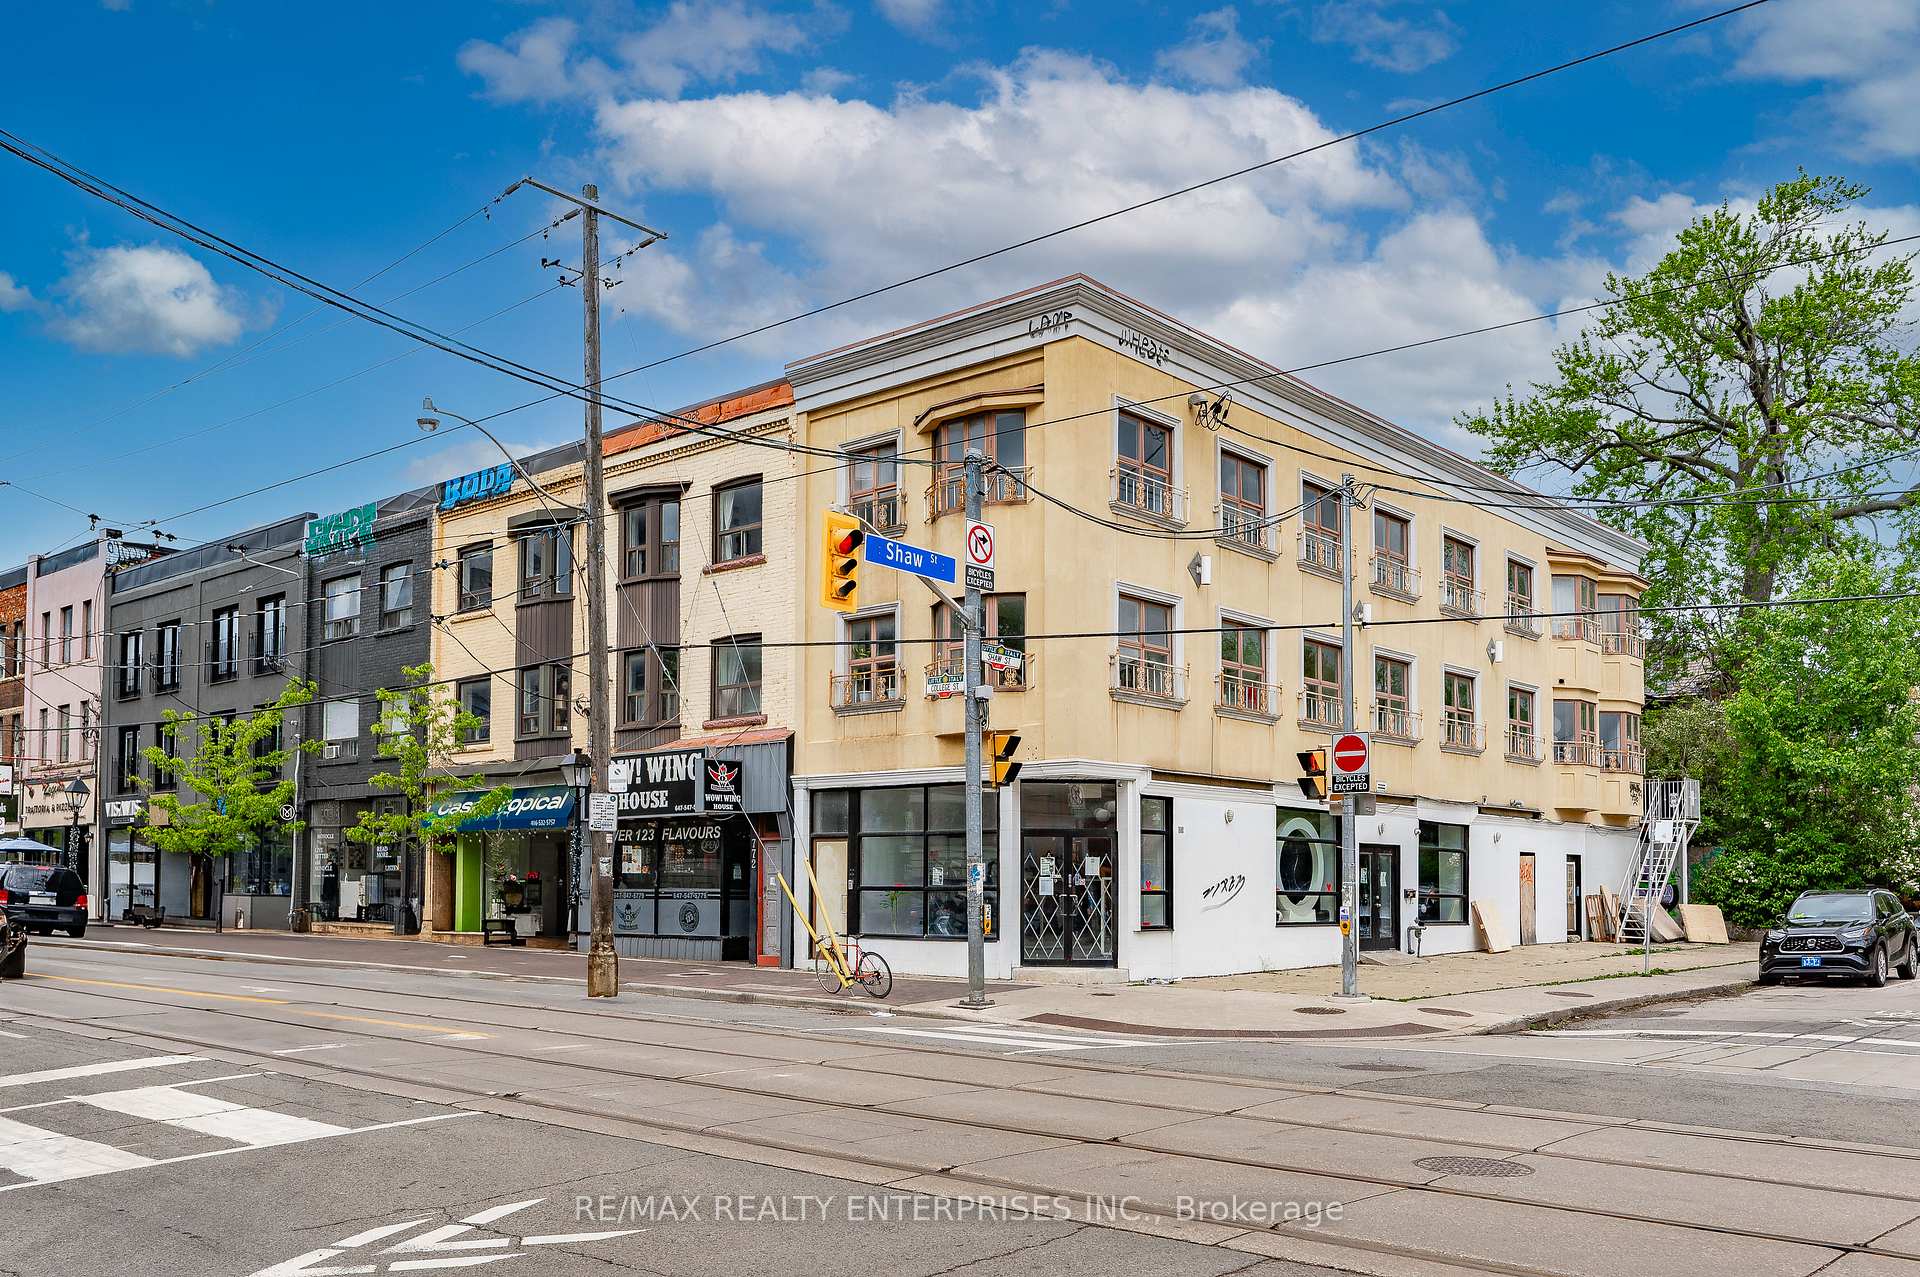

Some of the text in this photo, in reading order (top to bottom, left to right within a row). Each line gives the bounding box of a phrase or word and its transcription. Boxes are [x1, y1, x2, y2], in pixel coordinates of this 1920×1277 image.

[886, 542, 938, 568] Shaw St
[968, 568, 992, 580] BICYCLES
[967, 576, 993, 589] EXCEPTED
[987, 653, 1012, 664] SHAW ST
[1004, 648, 1021, 659] ITALY
[931, 682, 960, 692] COLLEGE ST
[1335, 774, 1366, 783] BICYCLES
[1334, 782, 1368, 791] EXCEPTED
[618, 790, 669, 810] HOUSE
[723, 794, 741, 803] WING
[635, 829, 655, 841] 123
[662, 825, 721, 841] FLAVOURS
